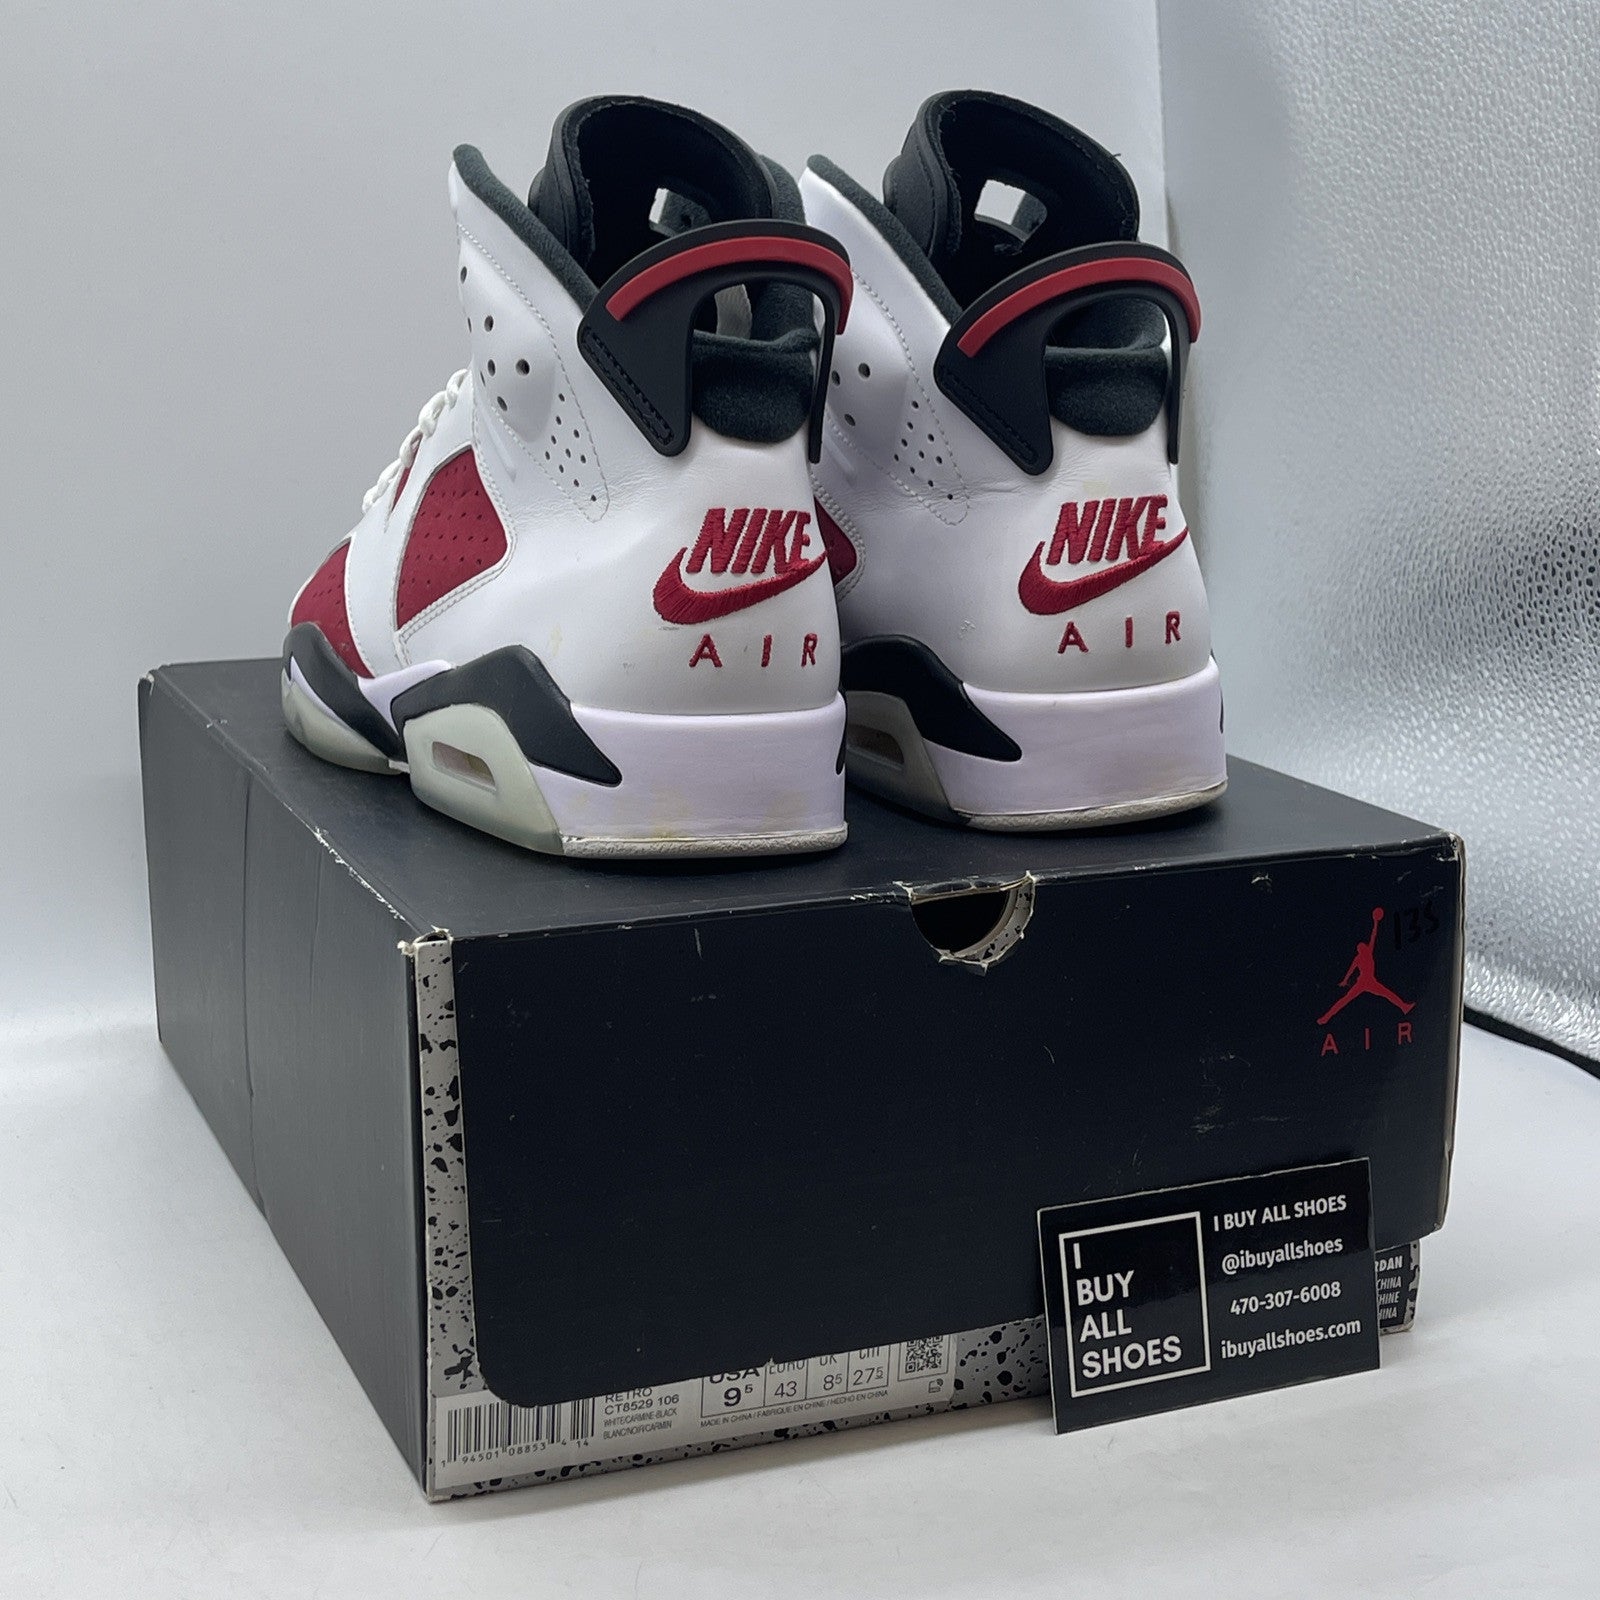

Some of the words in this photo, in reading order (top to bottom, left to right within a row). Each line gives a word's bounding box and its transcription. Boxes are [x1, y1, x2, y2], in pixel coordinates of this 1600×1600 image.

[686, 508, 812, 574] NIKE
[1046, 494, 1169, 565] NIKE
[689, 633, 818, 668] AIR
[1057, 611, 1182, 654] AIR
[1320, 1022, 1414, 1057] AIR
[1213, 1215, 1220, 1232] I
[1223, 1209, 1257, 1230] BUY
[1261, 1204, 1291, 1224] ALL
[1294, 1195, 1347, 1218] SHOES
[1072, 1242, 1082, 1270] I
[1221, 1238, 1344, 1275] @ibuyallshoes
[1076, 1269, 1135, 1306] BUY
[1230, 1281, 1342, 1315] 470-307-6008
[1079, 1308, 1132, 1343] ALL
[1221, 1319, 1361, 1359] ibuyallshoes.com
[1082, 1335, 1182, 1379] SHOES
[604, 1398, 653, 1415] CT8529
[658, 1394, 680, 1406] 106
[605, 1387, 652, 1403] RETRO
[774, 1381, 797, 1398] 43
[700, 1418, 719, 1427] MADE
[731, 1412, 752, 1422] CHINA
[804, 1401, 825, 1410] CHINE
[830, 1395, 855, 1405] HECHO
[856, 1393, 866, 1401] EN
[867, 1390, 889, 1399] CHINA
[462, 1450, 499, 1464] 94501
[508, 1441, 547, 1456] 08853
[576, 1439, 589, 1448] 14
